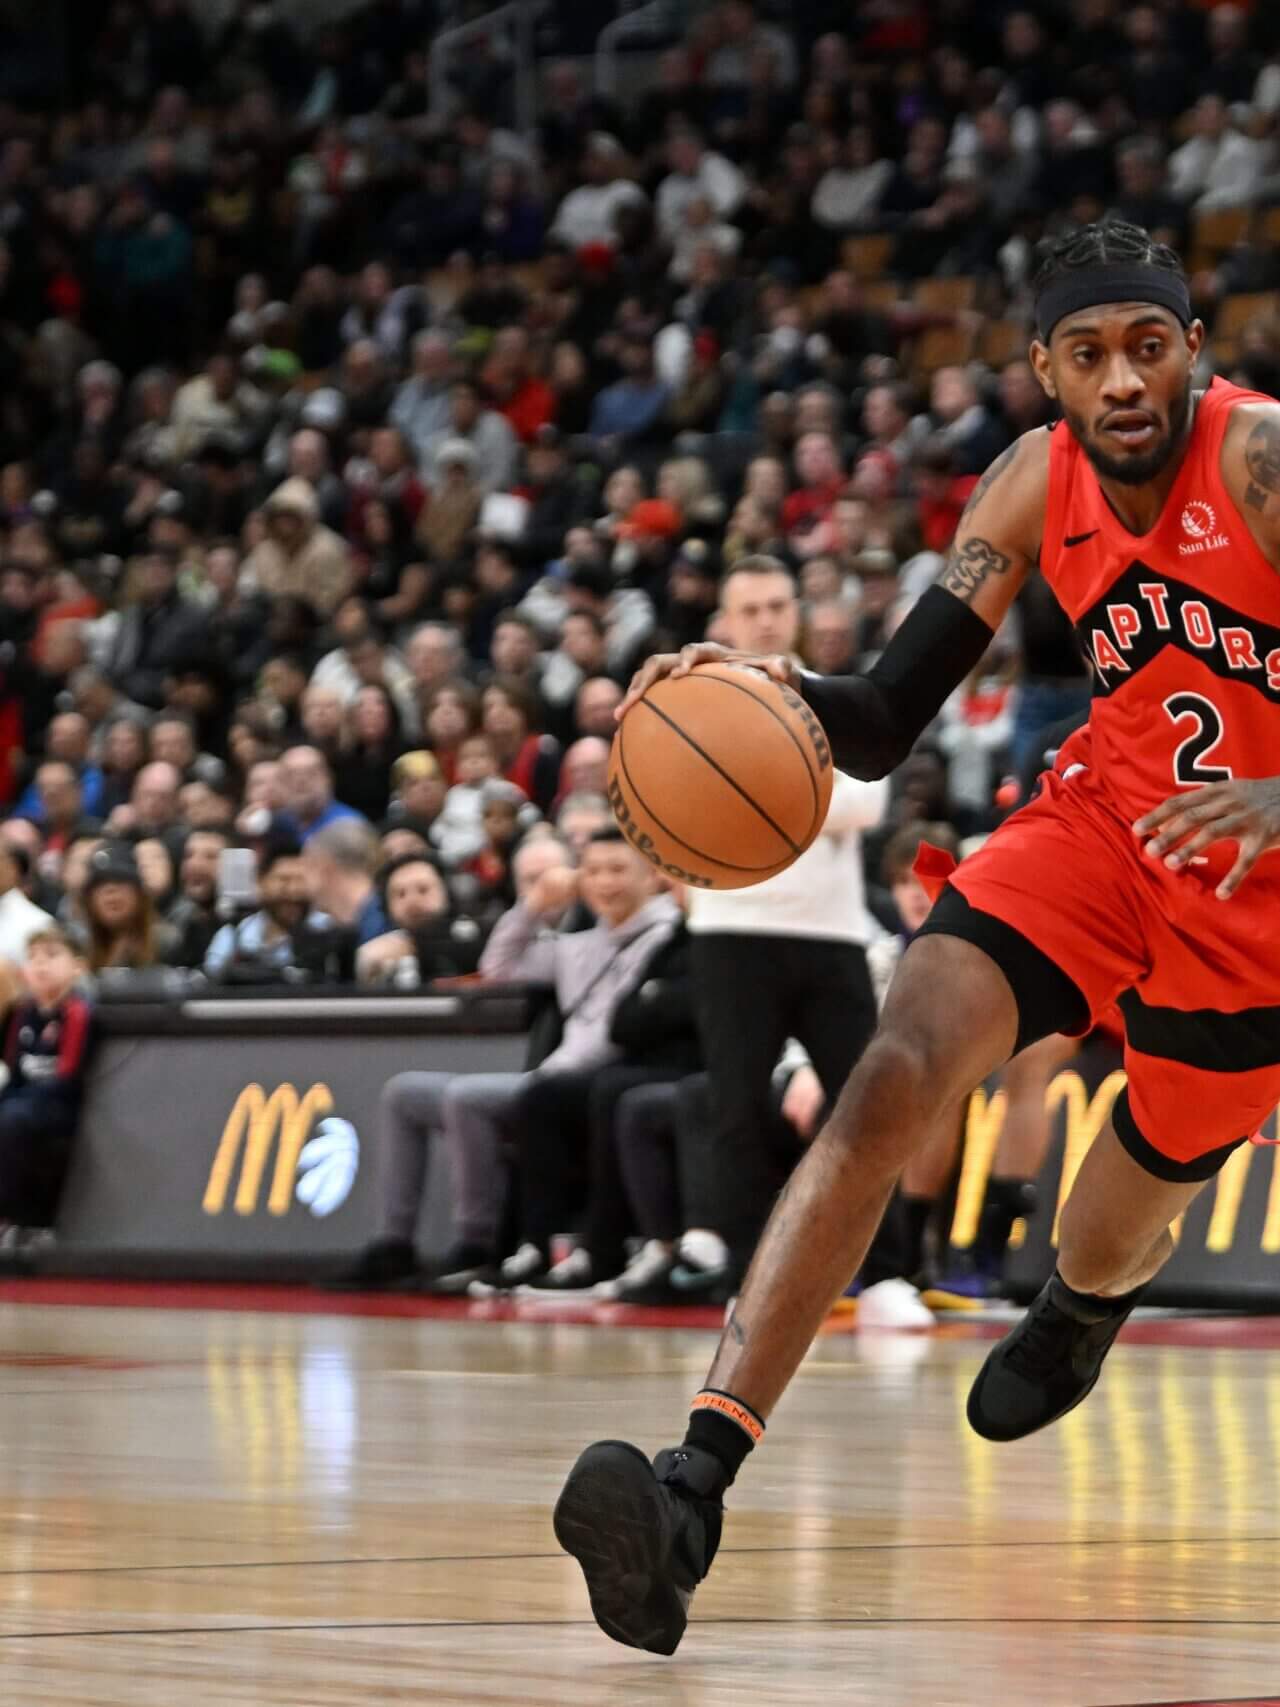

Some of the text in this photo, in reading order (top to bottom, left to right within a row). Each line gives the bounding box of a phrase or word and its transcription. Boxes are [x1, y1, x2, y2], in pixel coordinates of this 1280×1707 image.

[1178, 533, 1230, 555] Sun Life
[1162, 691, 1232, 785] 2
